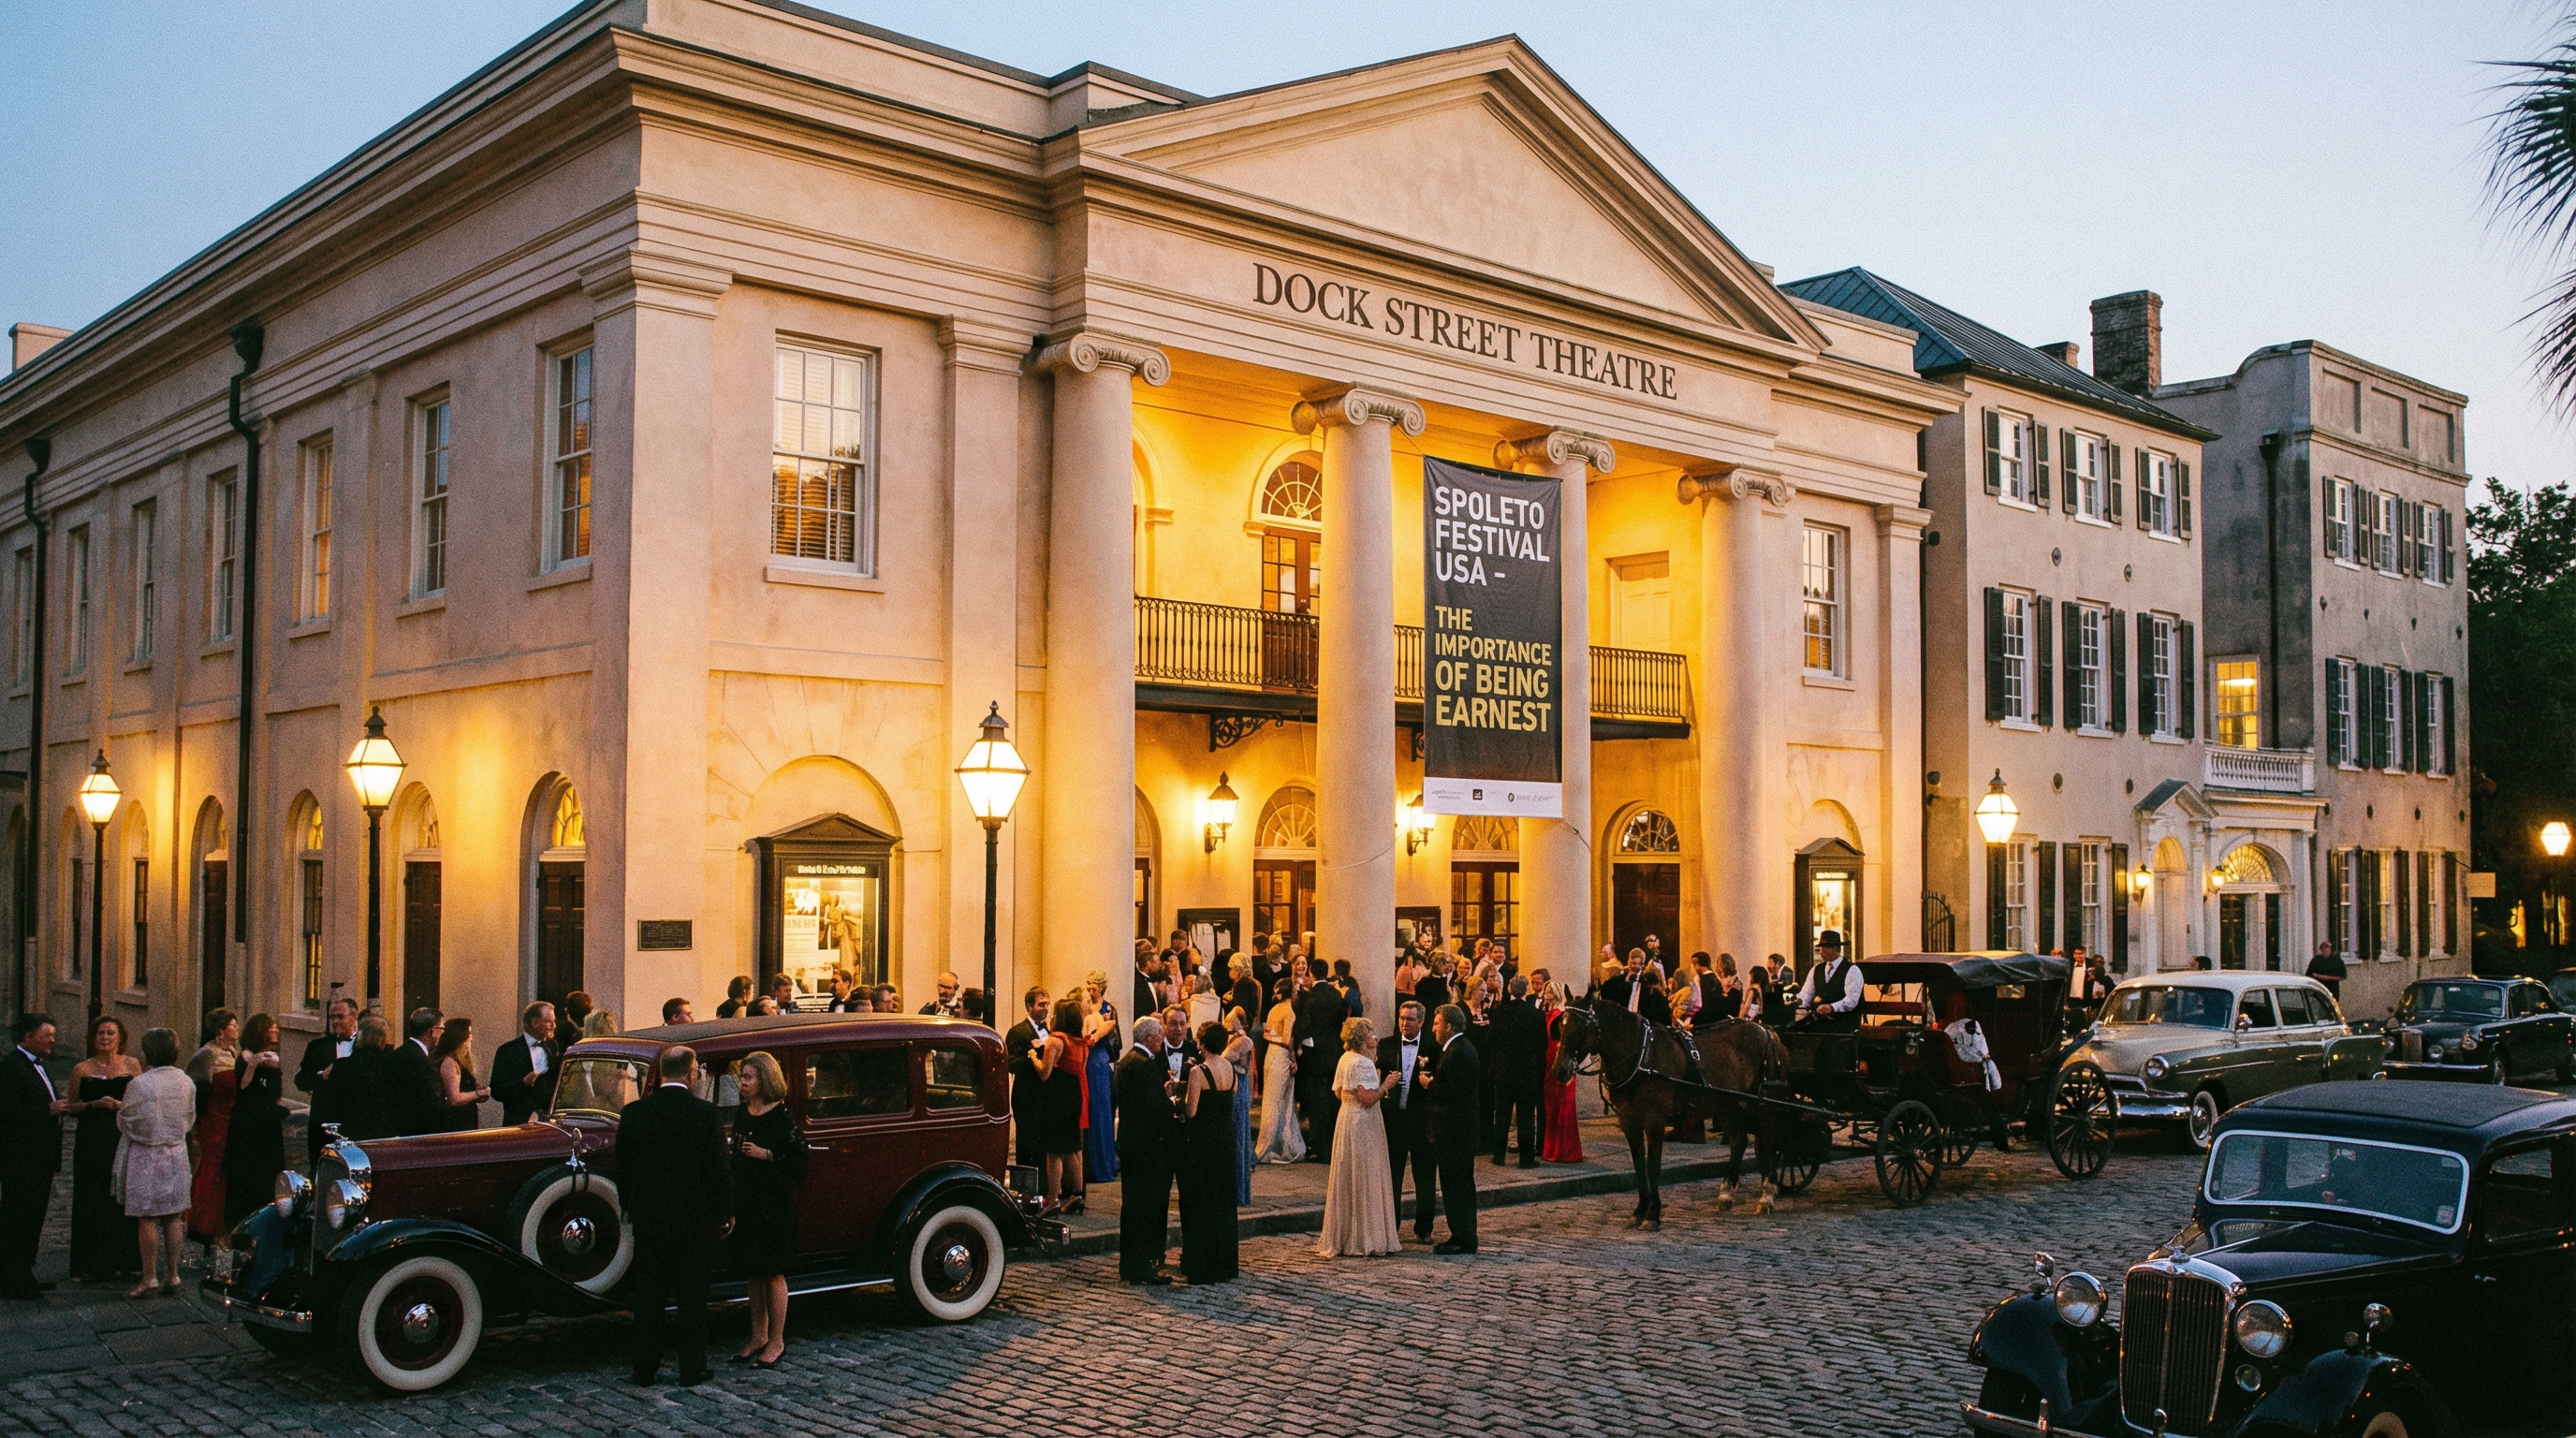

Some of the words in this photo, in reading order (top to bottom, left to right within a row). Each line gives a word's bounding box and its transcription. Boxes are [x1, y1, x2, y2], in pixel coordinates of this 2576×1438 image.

[1253, 262, 1374, 330] DOCK
[1384, 297, 1520, 362] STREET
[1530, 331, 1677, 400] THEATRE
[1435, 486, 1544, 530] SPOLETO
[1435, 519, 1550, 563] FESTIVAL
[1435, 551, 1487, 586] USA
[1435, 605, 1472, 632] THE
[1435, 633, 1552, 667] IMPORTANCE
[1435, 660, 1470, 691] OF
[1476, 664, 1549, 698] BEING
[1435, 695, 1551, 732] EARNEST
